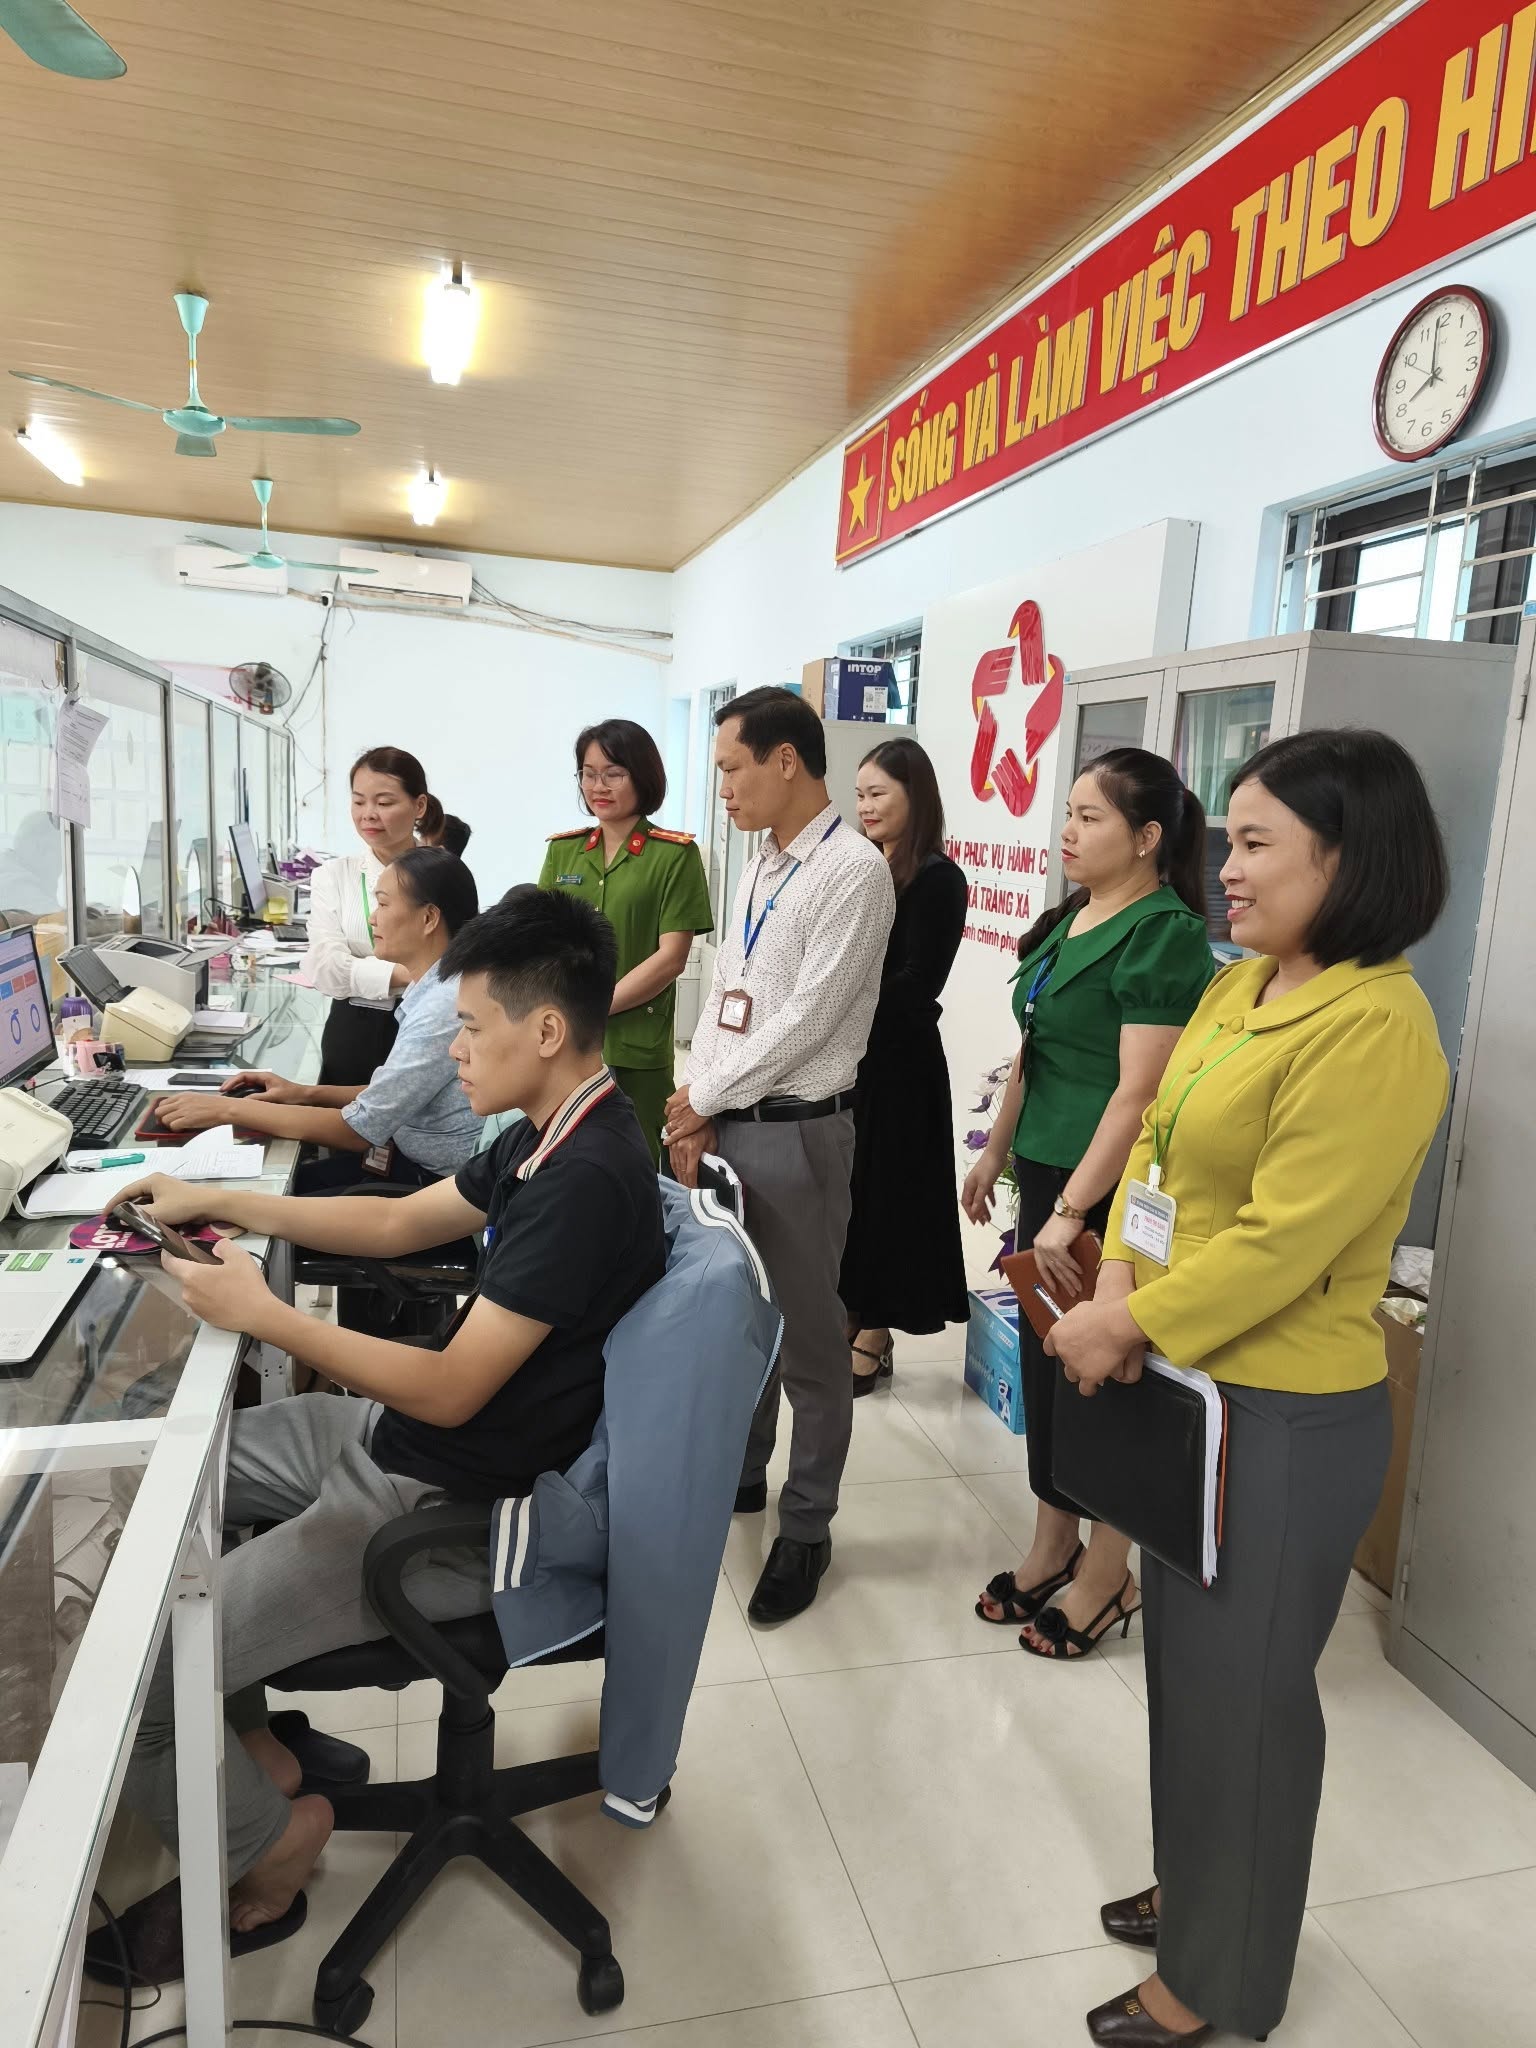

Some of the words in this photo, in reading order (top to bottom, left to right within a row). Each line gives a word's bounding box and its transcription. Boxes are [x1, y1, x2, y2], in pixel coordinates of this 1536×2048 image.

[888, 390, 957, 512] SỐNG
[961, 353, 999, 471] VÀ
[1004, 315, 1094, 448] LÀM
[1100, 224, 1210, 396] VIỆC
[1229, 96, 1410, 322] THEO
[1429, 0, 1536, 210] HI
[1464, 330, 1478, 348] 2
[1465, 355, 1478, 372] 3
[1395, 379, 1407, 395] 9
[1455, 383, 1468, 399] 4
[1395, 403, 1408, 418] 8
[1440, 408, 1452, 425] 5
[1406, 419, 1417, 434] 7
[1421, 421, 1433, 437] 6
[963, 841, 989, 873] PHỤC
[991, 843, 1005, 876] VỤ
[1006, 839, 1036, 874] HÀNH
[1038, 848, 1048, 876] C
[981, 883, 1014, 916] TRÀNG
[1015, 888, 1030, 919] XÁ
[977, 924, 999, 948] chính
[1000, 930, 1018, 956] phụ
